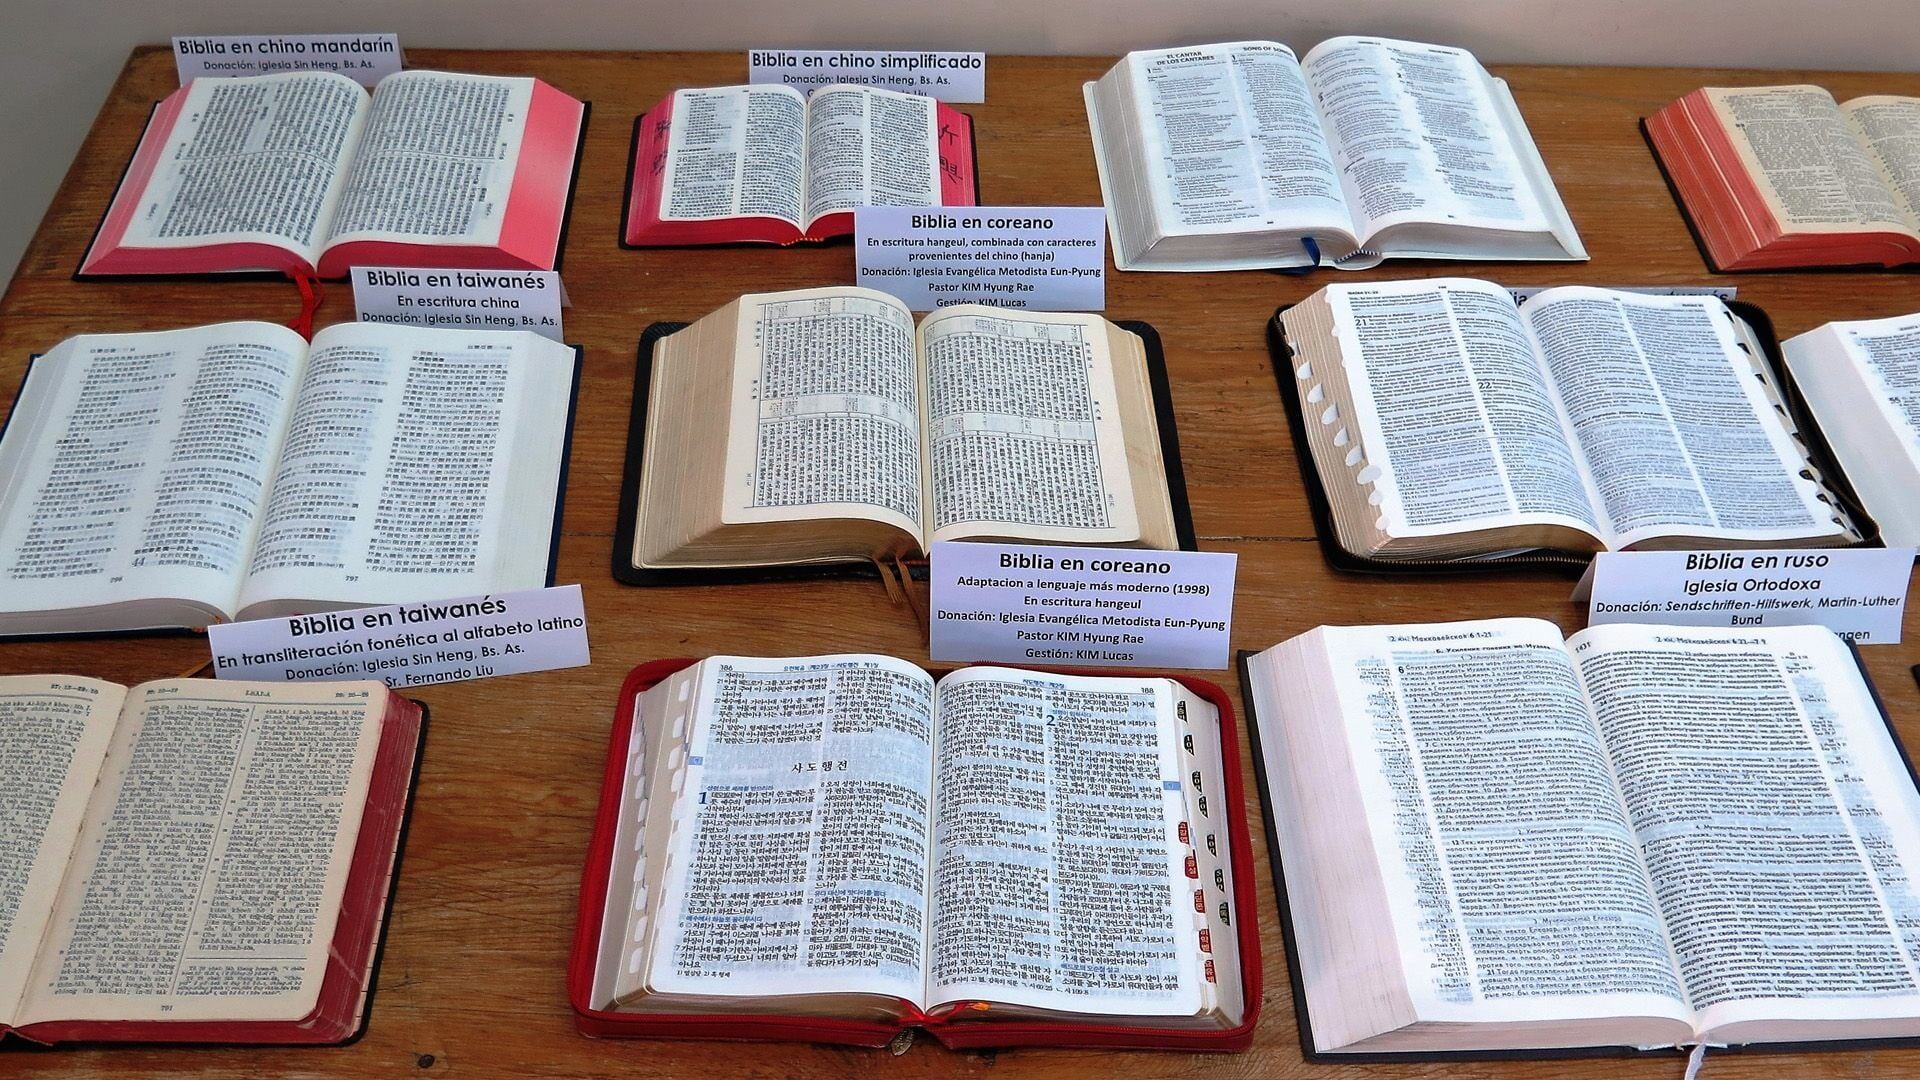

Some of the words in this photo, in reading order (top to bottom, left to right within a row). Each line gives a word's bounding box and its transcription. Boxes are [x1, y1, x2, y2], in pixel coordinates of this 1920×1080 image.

[180, 40, 225, 54] Biblia
[232, 42, 252, 54] en
[259, 39, 305, 53] chino
[312, 37, 393, 53] mandarín
[204, 60, 255, 70] Donación:
[259, 61, 291, 70] Iglesia
[295, 61, 309, 69] Sin
[361, 60, 375, 69] As.
[753, 53, 796, 67] Biblia
[803, 56, 823, 67] en
[829, 54, 874, 68] chino
[881, 54, 981, 71] simplificado
[783, 74, 833, 84] Donación:
[872, 75, 885, 84] Sin
[889, 76, 917, 86] Heng,
[920, 76, 932, 84] Bs.
[937, 76, 950, 84] As.
[912, 215, 956, 228] Biblia
[963, 218, 982, 229] en
[988, 218, 1053, 229] coreano
[868, 238, 879, 246] En
[882, 238, 924, 246] escritura
[927, 238, 968, 249] hangeul,
[971, 238, 1026, 246] combinada
[1047, 239, 1096, 247] caracteres
[909, 253, 972, 262] provenientes
[975, 252, 989, 260] del
[992, 252, 1019, 260] chino
[1021, 252, 1055, 263] (hanja)
[862, 267, 910, 276] Donación:
[913, 268, 943, 278] Iglesia
[947, 267, 995, 278] Evangélica
[999, 267, 1047, 276] Metodista
[1051, 268, 1101, 278] Eun-Pyung
[368, 272, 420, 286] Biblia
[427, 275, 450, 287] en
[457, 272, 545, 289] taiwanés
[929, 283, 959, 291] Pastor
[984, 284, 1013, 293] Hyung
[398, 296, 414, 306] En
[418, 297, 476, 308] escritura
[481, 297, 519, 309] china
[979, 299, 998, 307] KIM
[1001, 299, 1026, 307] Lucas
[363, 313, 421, 323] Donación:
[425, 314, 462, 326] Iglesia
[466, 314, 481, 324] Sin
[486, 316, 517, 327] Heng,
[523, 317, 537, 325] Bs.
[542, 317, 558, 326] As.
[1478, 381, 1492, 389] 22
[1000, 553, 1053, 570] Biblia
[1061, 559, 1083, 571] en
[1091, 560, 1171, 574] coreano
[1686, 554, 1744, 570] Biblia
[1751, 557, 1778, 569] en
[1783, 554, 1829, 567] ruso
[957, 577, 1023, 588] Adaptacion
[1037, 579, 1086, 592] lenguaje
[1090, 581, 1113, 591] más
[1117, 582, 1169, 593] moderno
[1173, 584, 1210, 596] (1998)
[1684, 579, 1738, 595] Iglesia
[1744, 579, 1820, 592] Ortodoxa
[1024, 596, 1038, 605] En
[1042, 596, 1091, 607] escritura
[1095, 599, 1141, 609] hangeul
[1596, 601, 1662, 613] Donación:
[1665, 598, 1814, 612] Sendschriften-Hilfswerk,
[1818, 596, 1901, 608] Martin-Luther
[290, 615, 355, 637] Biblia
[363, 611, 392, 628] en
[400, 596, 506, 625] taiwanés
[938, 610, 996, 622] Donación:
[999, 612, 1034, 624] Iglesia
[1039, 613, 1098, 625] Evangélica
[1102, 616, 1161, 627] Metodista
[1164, 618, 1225, 631] Eun-Pyung
[1731, 615, 1763, 625] Bund
[218, 656, 238, 669] En
[243, 639, 361, 667] transliteración
[368, 633, 437, 651] fonética
[443, 629, 458, 643] al
[463, 621, 532, 641] alfabeto
[538, 616, 583, 631] latino
[1017, 631, 1053, 641] Pastor
[1057, 632, 1080, 642] KIM
[1083, 633, 1119, 644] Hyung
[1123, 635, 1144, 644] Rae
[286, 662, 359, 680] Donación:
[363, 657, 408, 673] Iglesia
[412, 653, 432, 666] Sin
[437, 650, 478, 664] Heng,
[482, 646, 500, 658] Bs.
[504, 643, 524, 655] As.
[1026, 648, 1073, 659] Gestión:
[1076, 650, 1099, 660] KIM
[1103, 651, 1133, 661] Lucas
[385, 677, 401, 687] Sr.
[406, 669, 471, 685] Fernando
[476, 666, 493, 679] Liu
[1046, 714, 1055, 726] 2
